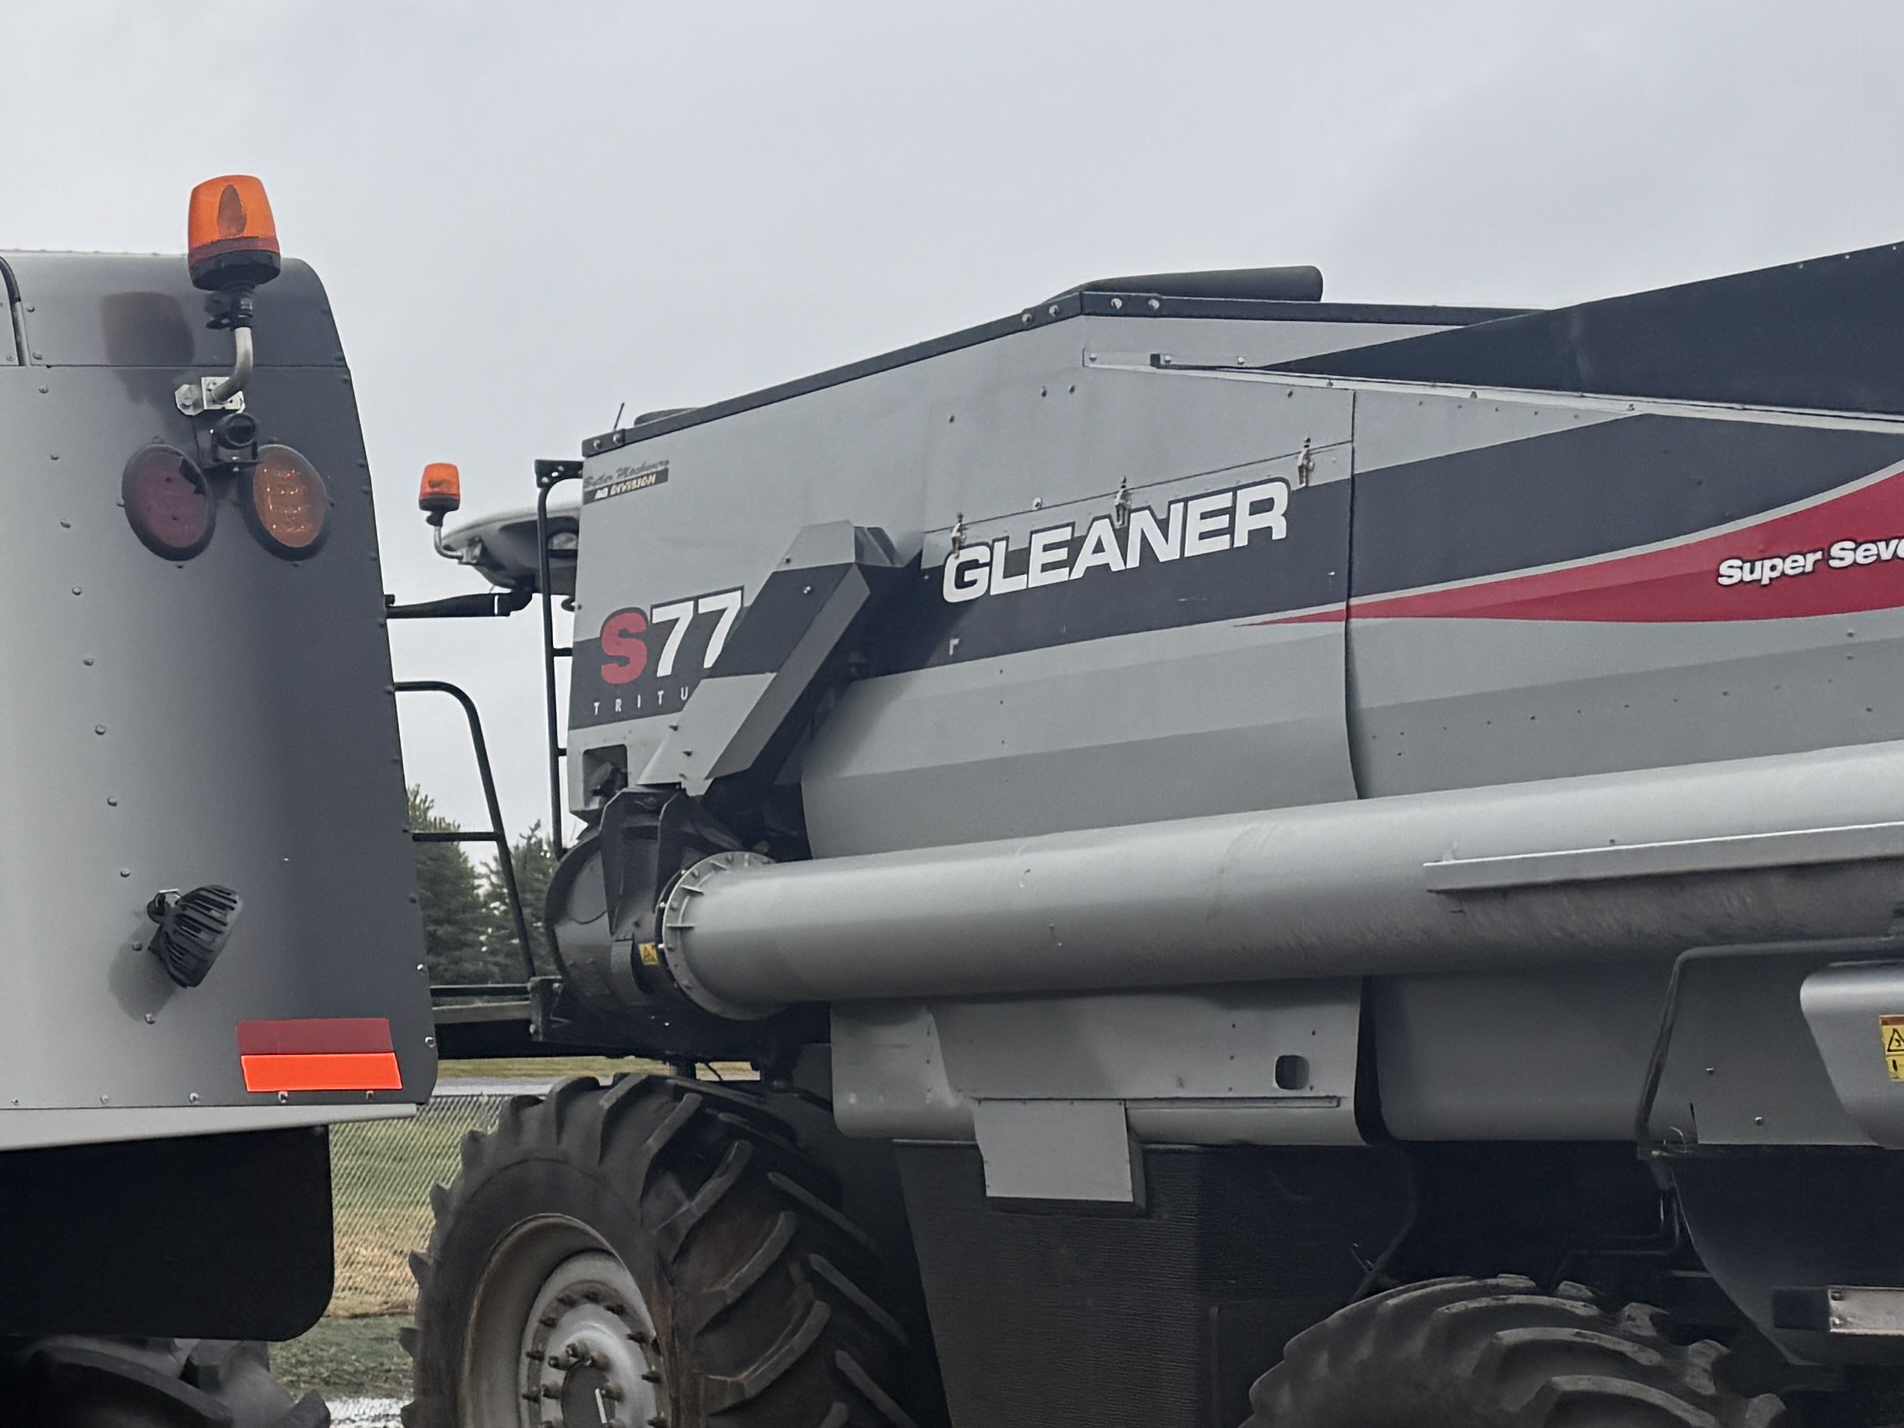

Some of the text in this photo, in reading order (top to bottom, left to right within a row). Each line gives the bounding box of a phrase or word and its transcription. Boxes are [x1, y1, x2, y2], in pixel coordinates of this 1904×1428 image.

[942, 479, 1290, 604] GLEANER
[1717, 550, 1823, 586] Super
[600, 587, 744, 685] S77
